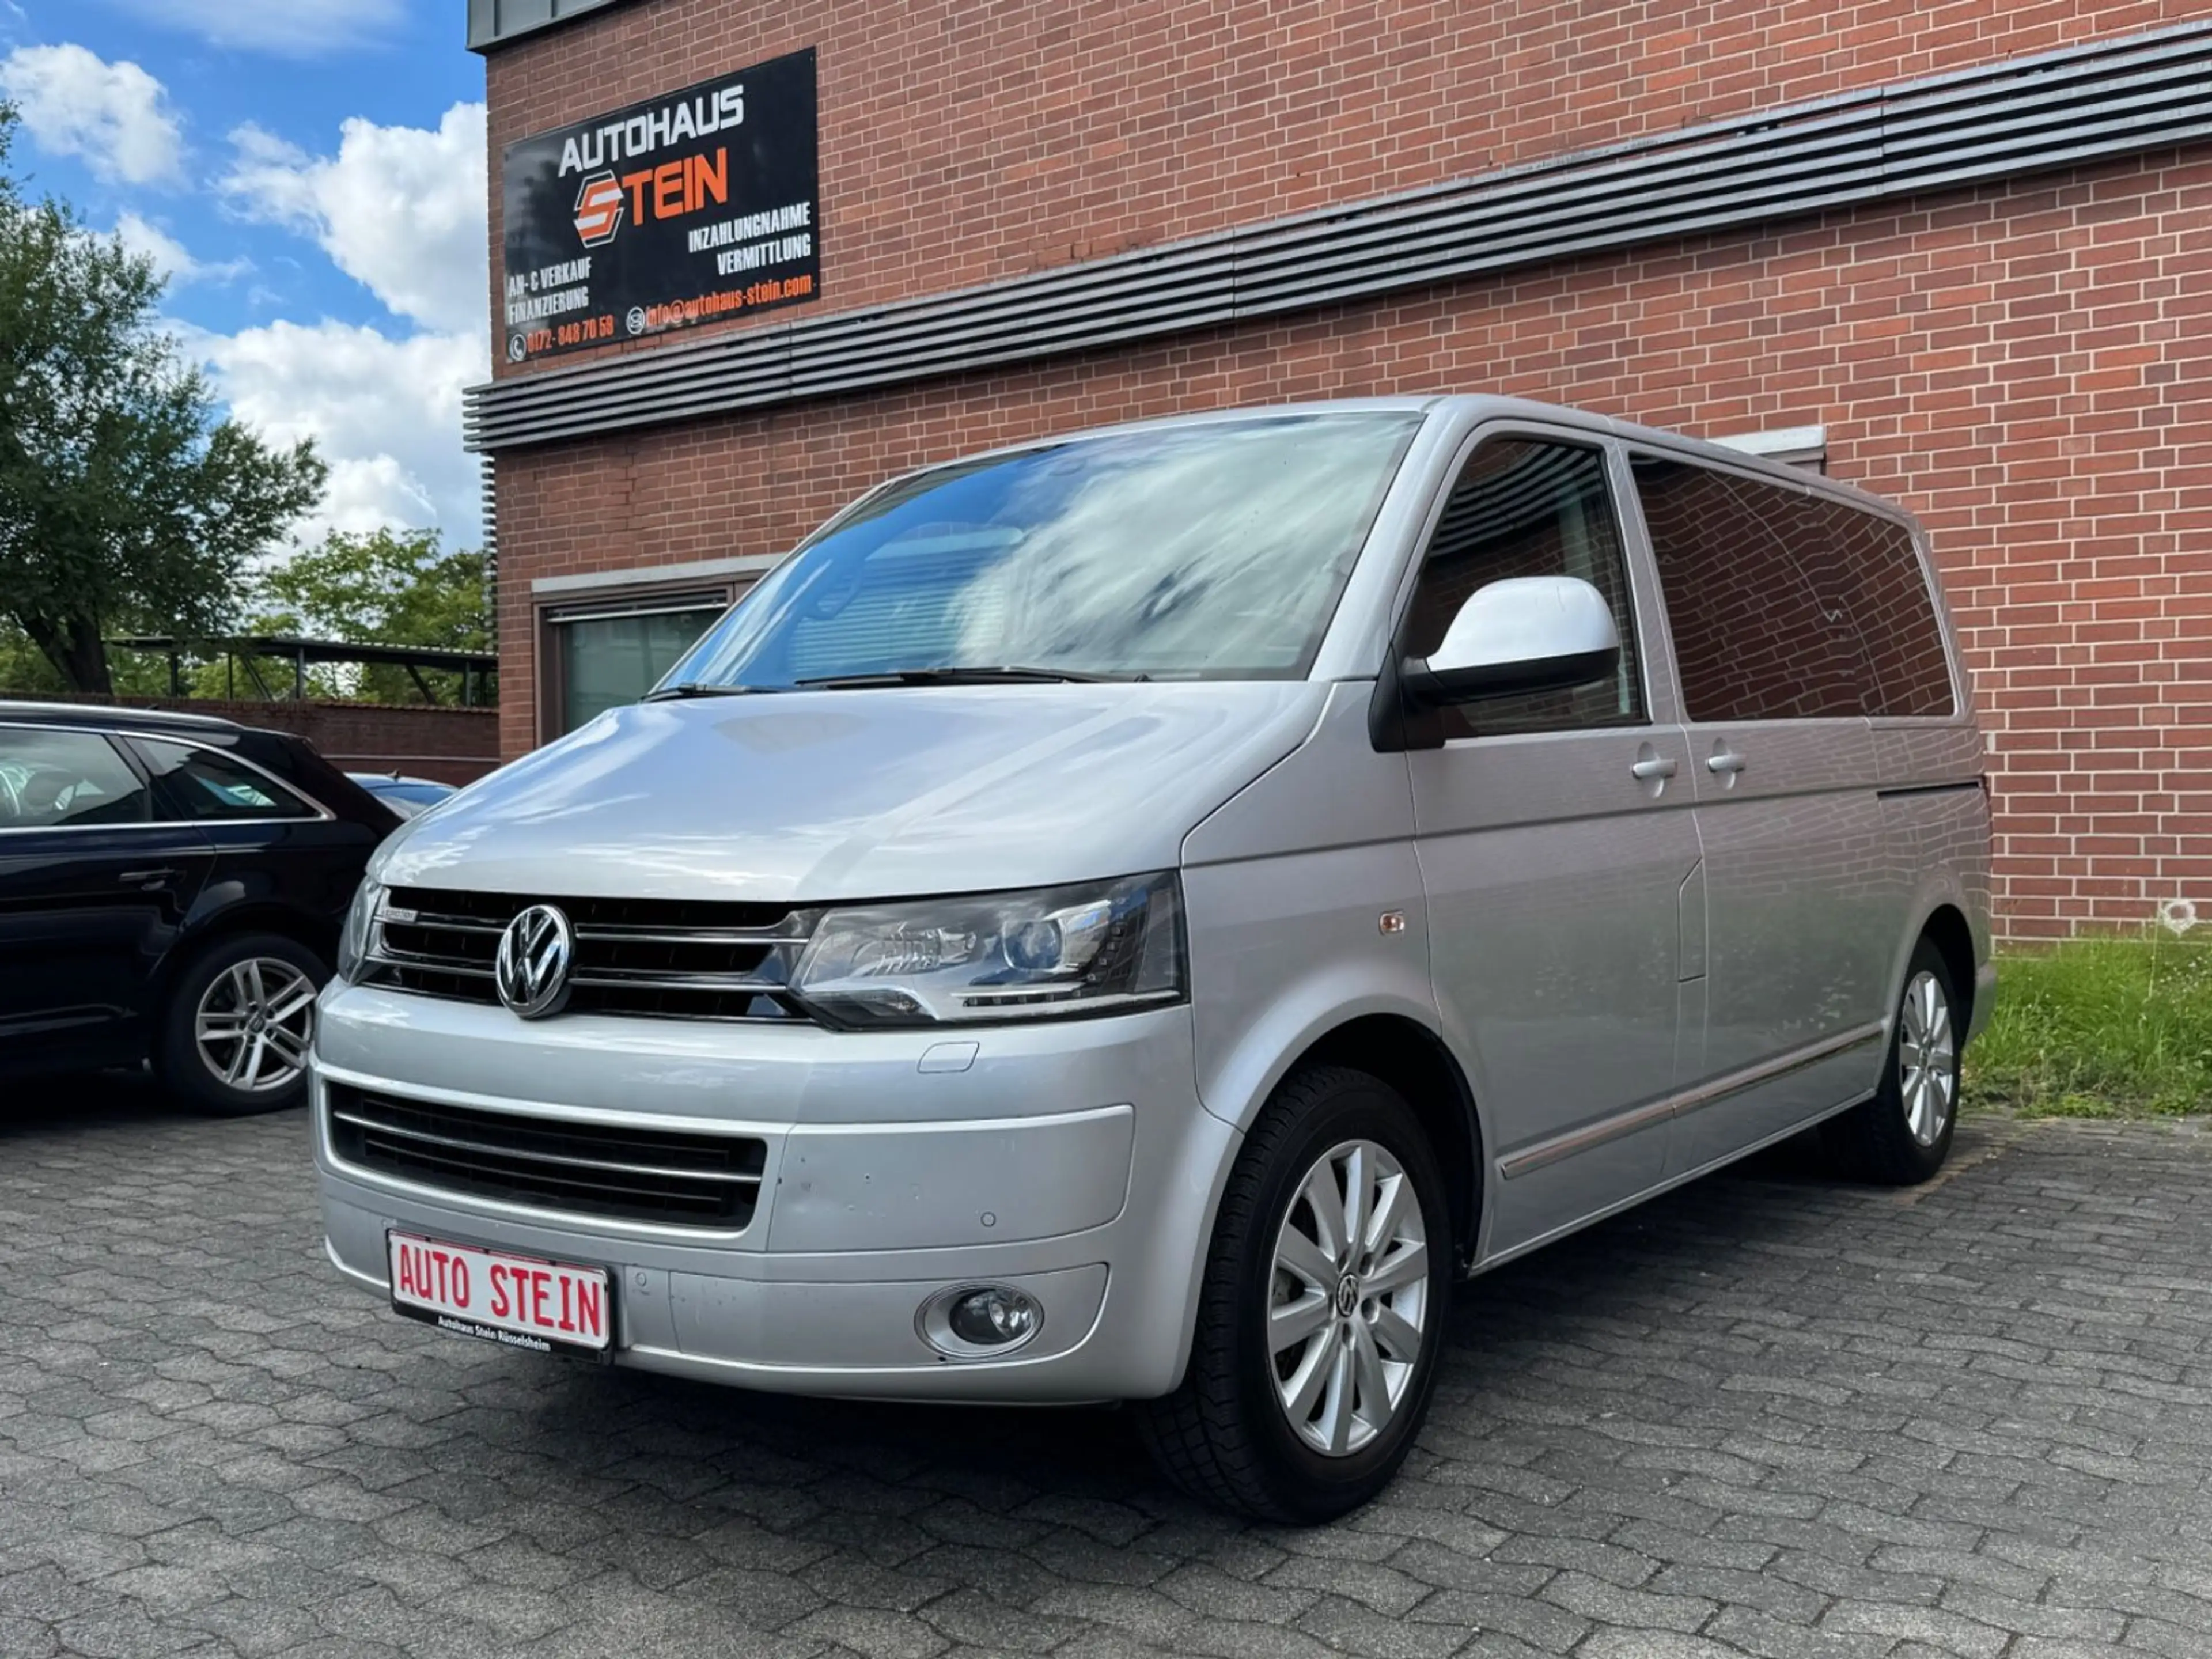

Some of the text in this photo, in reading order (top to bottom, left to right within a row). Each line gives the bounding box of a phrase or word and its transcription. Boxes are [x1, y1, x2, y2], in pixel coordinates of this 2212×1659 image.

[558, 84, 744, 177] AUTOHAUS
[574, 146, 728, 248] STEIN
[688, 202, 811, 253] INZAHLUNGNAHME
[509, 274, 528, 297] AN-
[539, 256, 592, 289] VERKAUF
[717, 233, 812, 276] VERMITTLUNG
[509, 285, 589, 325] FINANZIERUNG
[646, 274, 812, 327] info@autohaus-stein.com
[399, 1243, 601, 1338] AUTO STEIN
[438, 1315, 474, 1335] Autohaus
[475, 1324, 497, 1340] Stein
